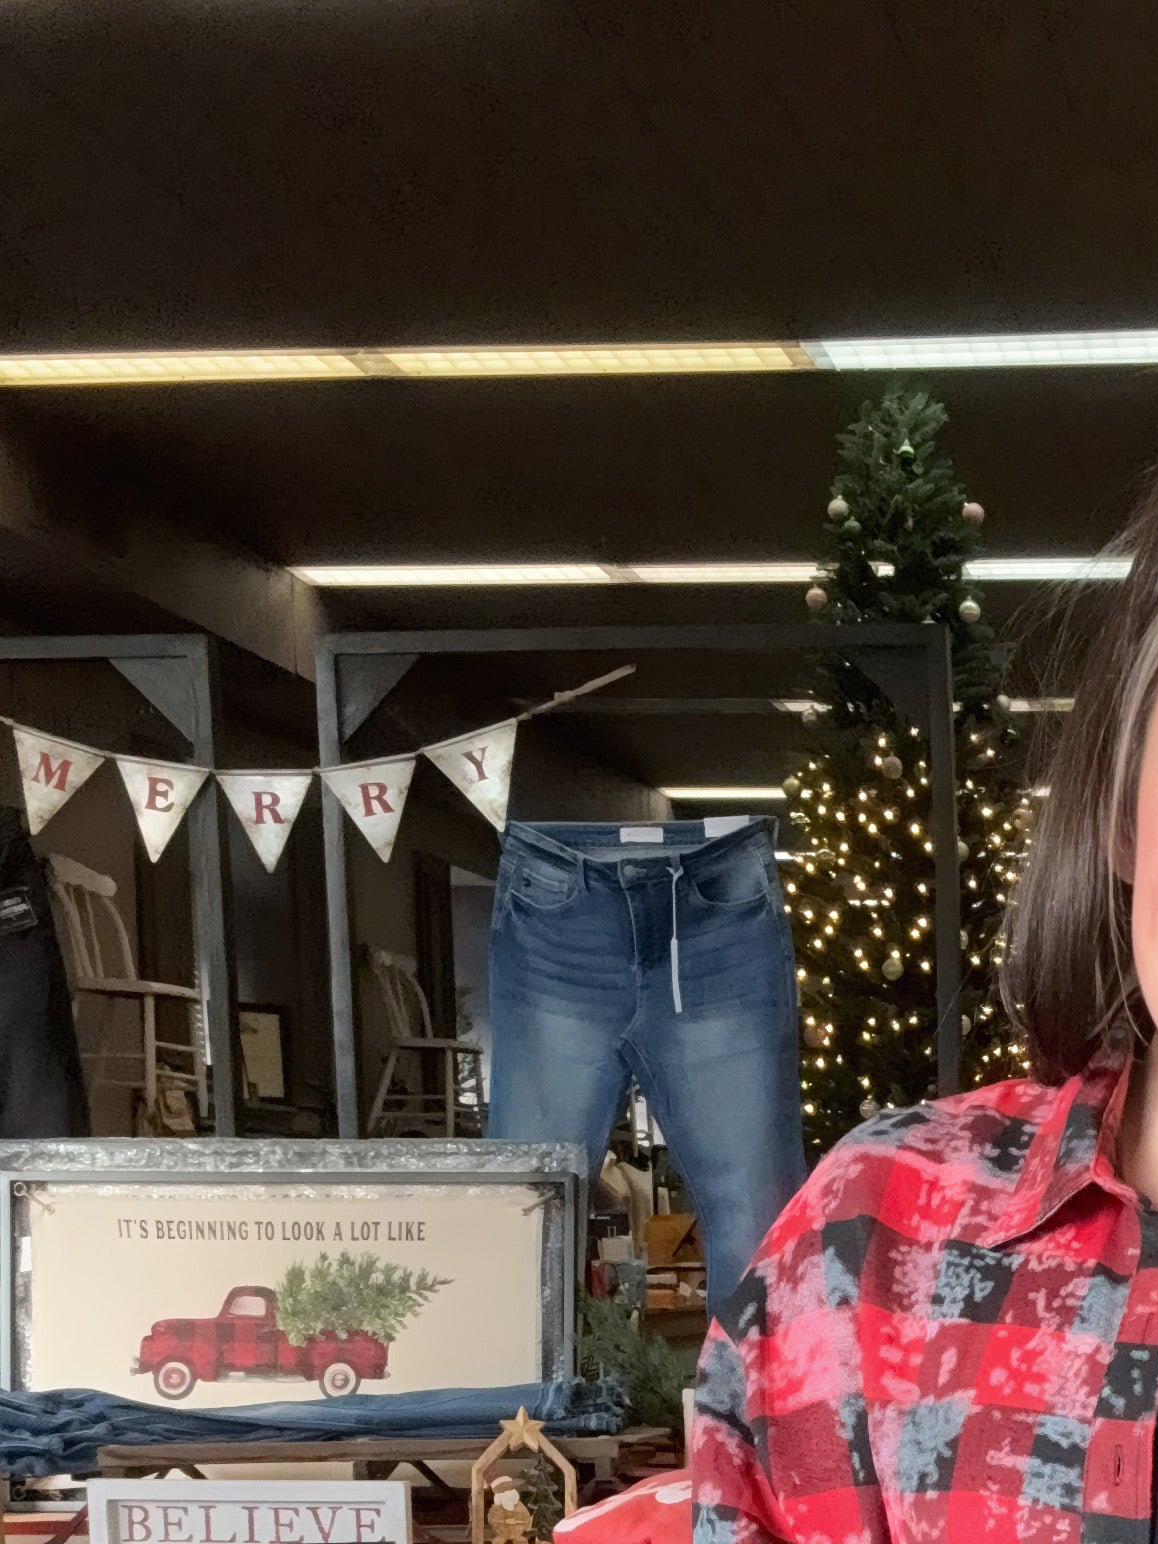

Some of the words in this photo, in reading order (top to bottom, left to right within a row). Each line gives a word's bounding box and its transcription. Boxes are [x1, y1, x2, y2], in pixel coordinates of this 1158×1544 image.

[32, 745, 489, 825] MERRY
[117, 1219, 149, 1239] IT'S
[156, 1220, 249, 1240] BEGINNING
[254, 1221, 275, 1240] TO
[282, 1221, 325, 1241] LOOK
[332, 1221, 343, 1242] A
[351, 1221, 381, 1242] LOT
[387, 1222, 426, 1242] LIKE
[120, 1504, 386, 1544] BELIEVE
